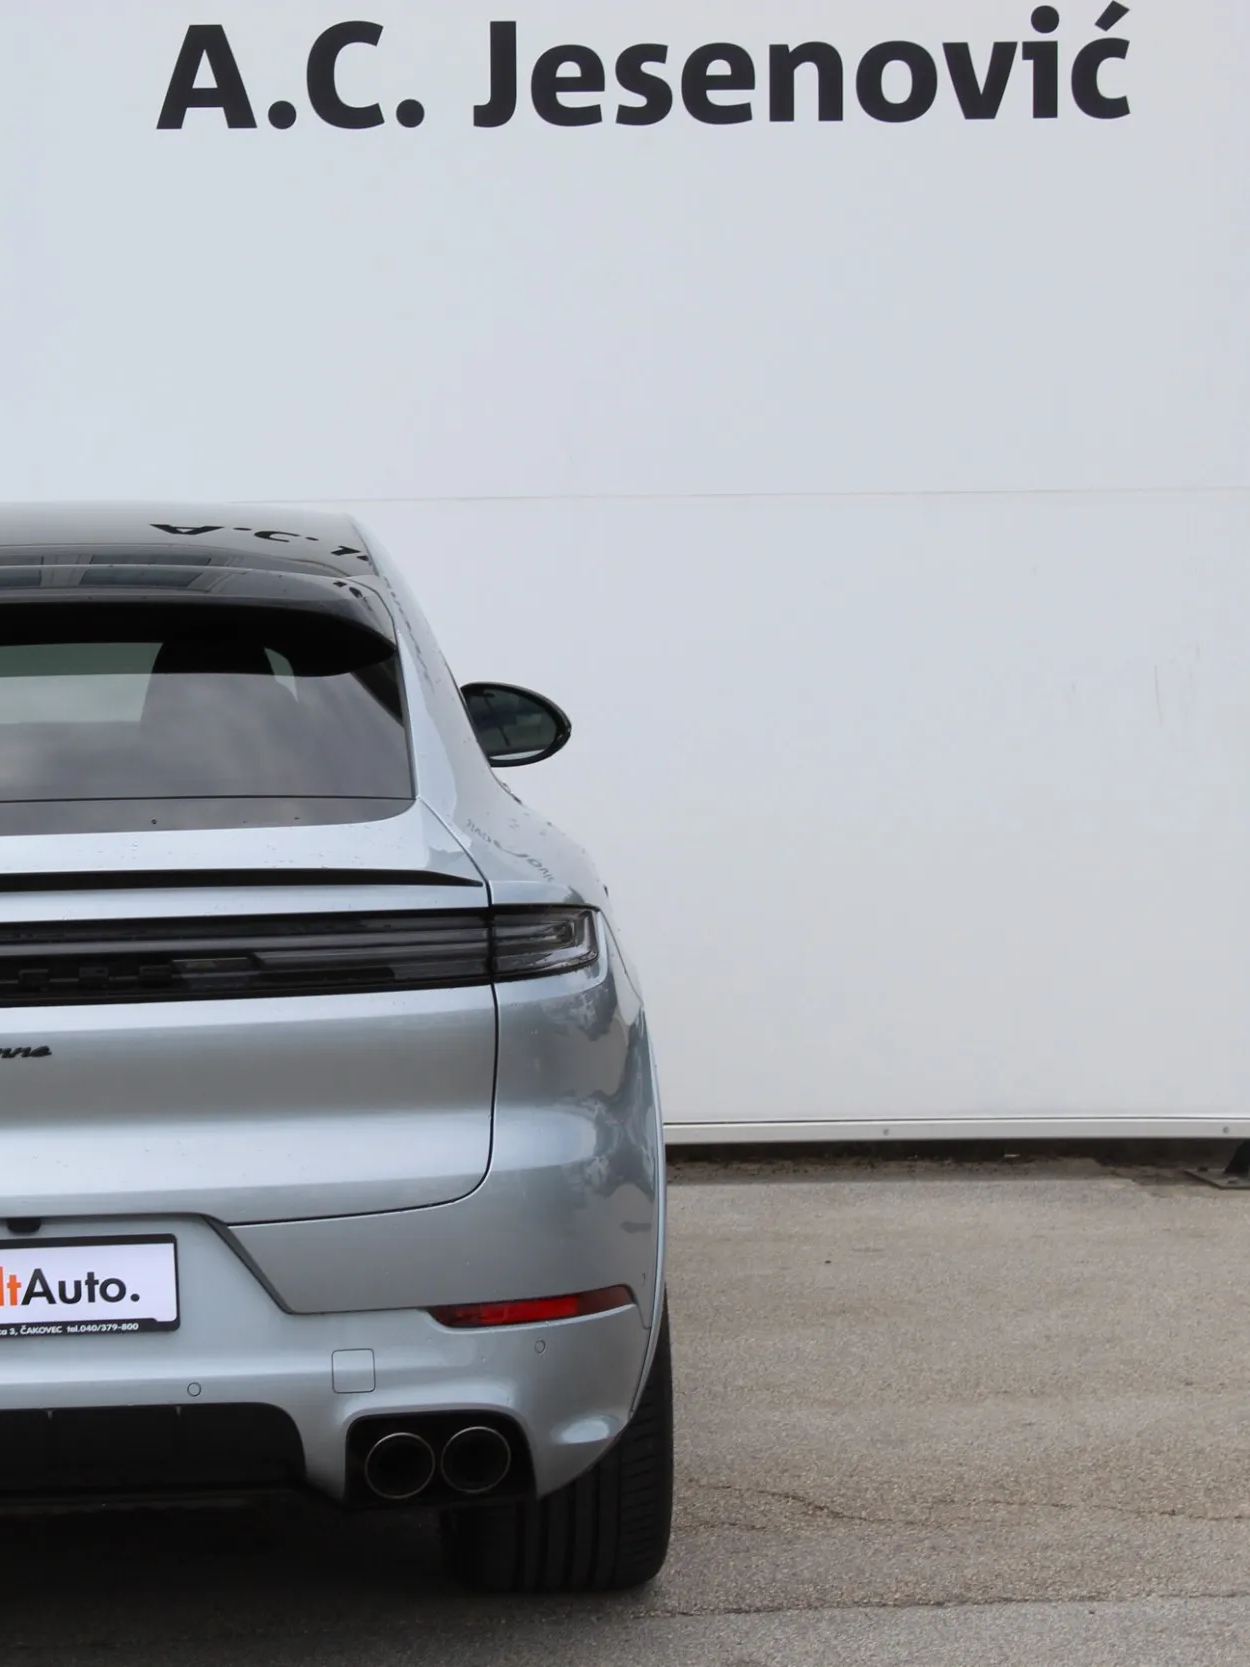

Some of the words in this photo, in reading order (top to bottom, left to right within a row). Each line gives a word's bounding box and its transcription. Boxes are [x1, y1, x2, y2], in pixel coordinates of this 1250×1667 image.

[156, 21, 425, 130] A.C.
[472, 0, 1132, 129] Jesenović
[19, 1325, 63, 1335] ČAKOVEC
